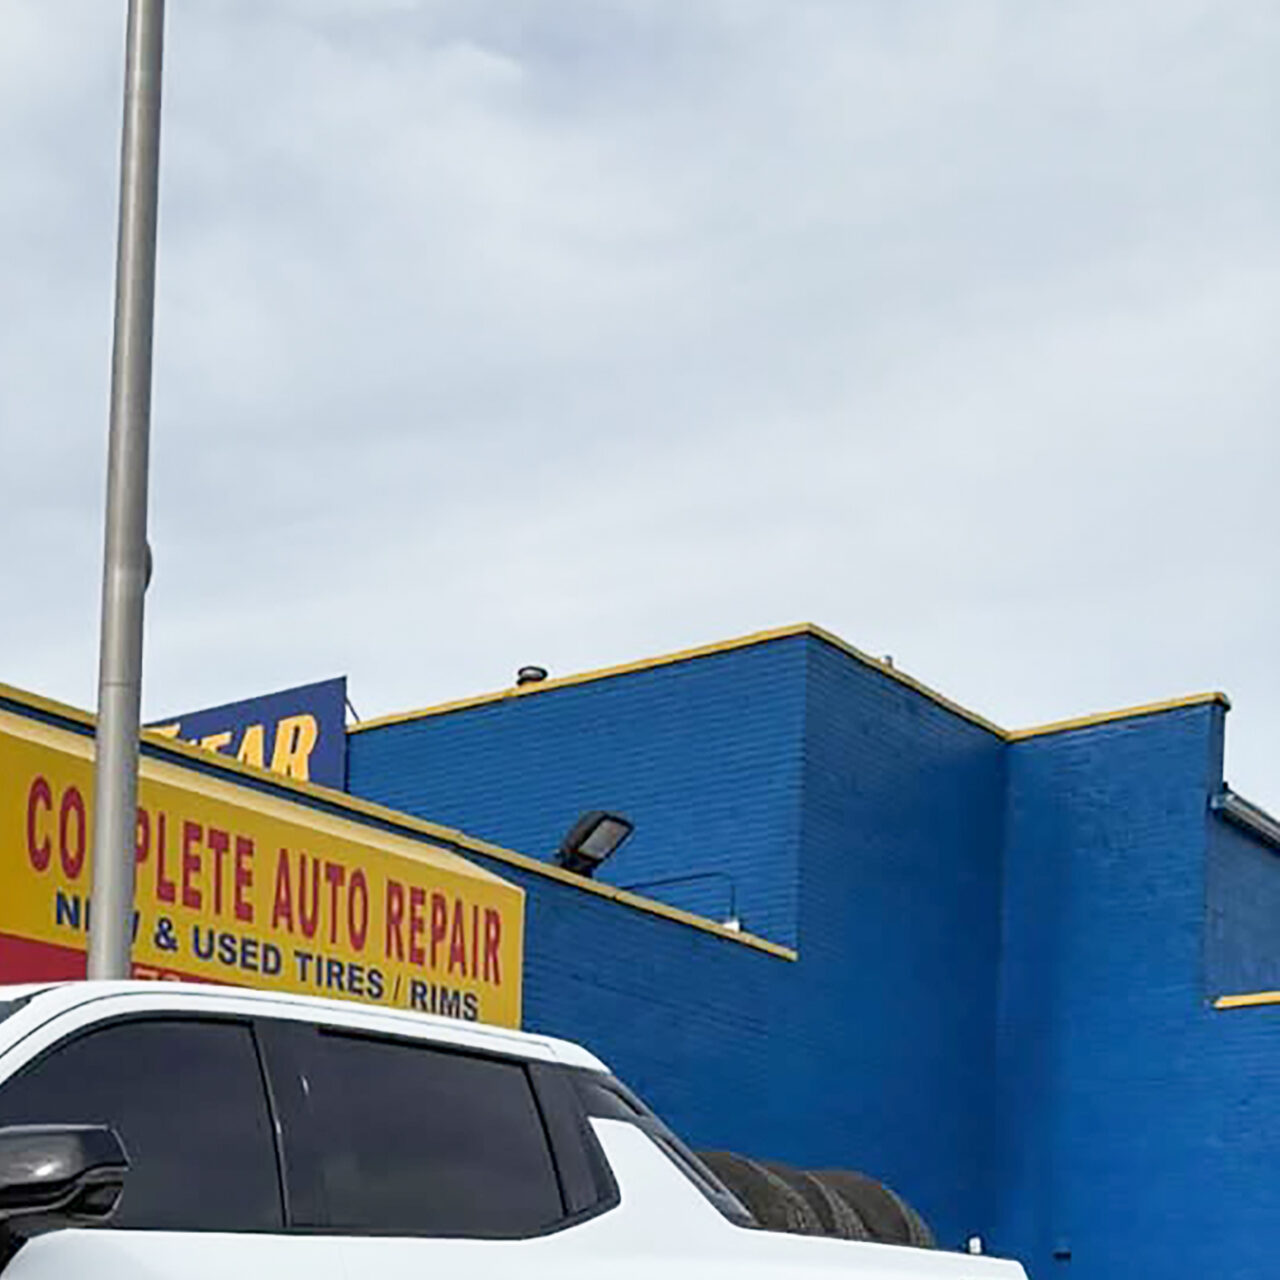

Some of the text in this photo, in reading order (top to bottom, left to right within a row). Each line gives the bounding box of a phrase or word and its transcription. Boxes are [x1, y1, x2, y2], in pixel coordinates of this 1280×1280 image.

[27, 774, 255, 923] COPLETE
[272, 847, 368, 952] AUTO
[385, 879, 501, 986] REPAIR
[153, 916, 179, 952] &
[193, 924, 282, 976] USED
[294, 949, 385, 1000] TIRES
[410, 978, 479, 1021] RIMS
